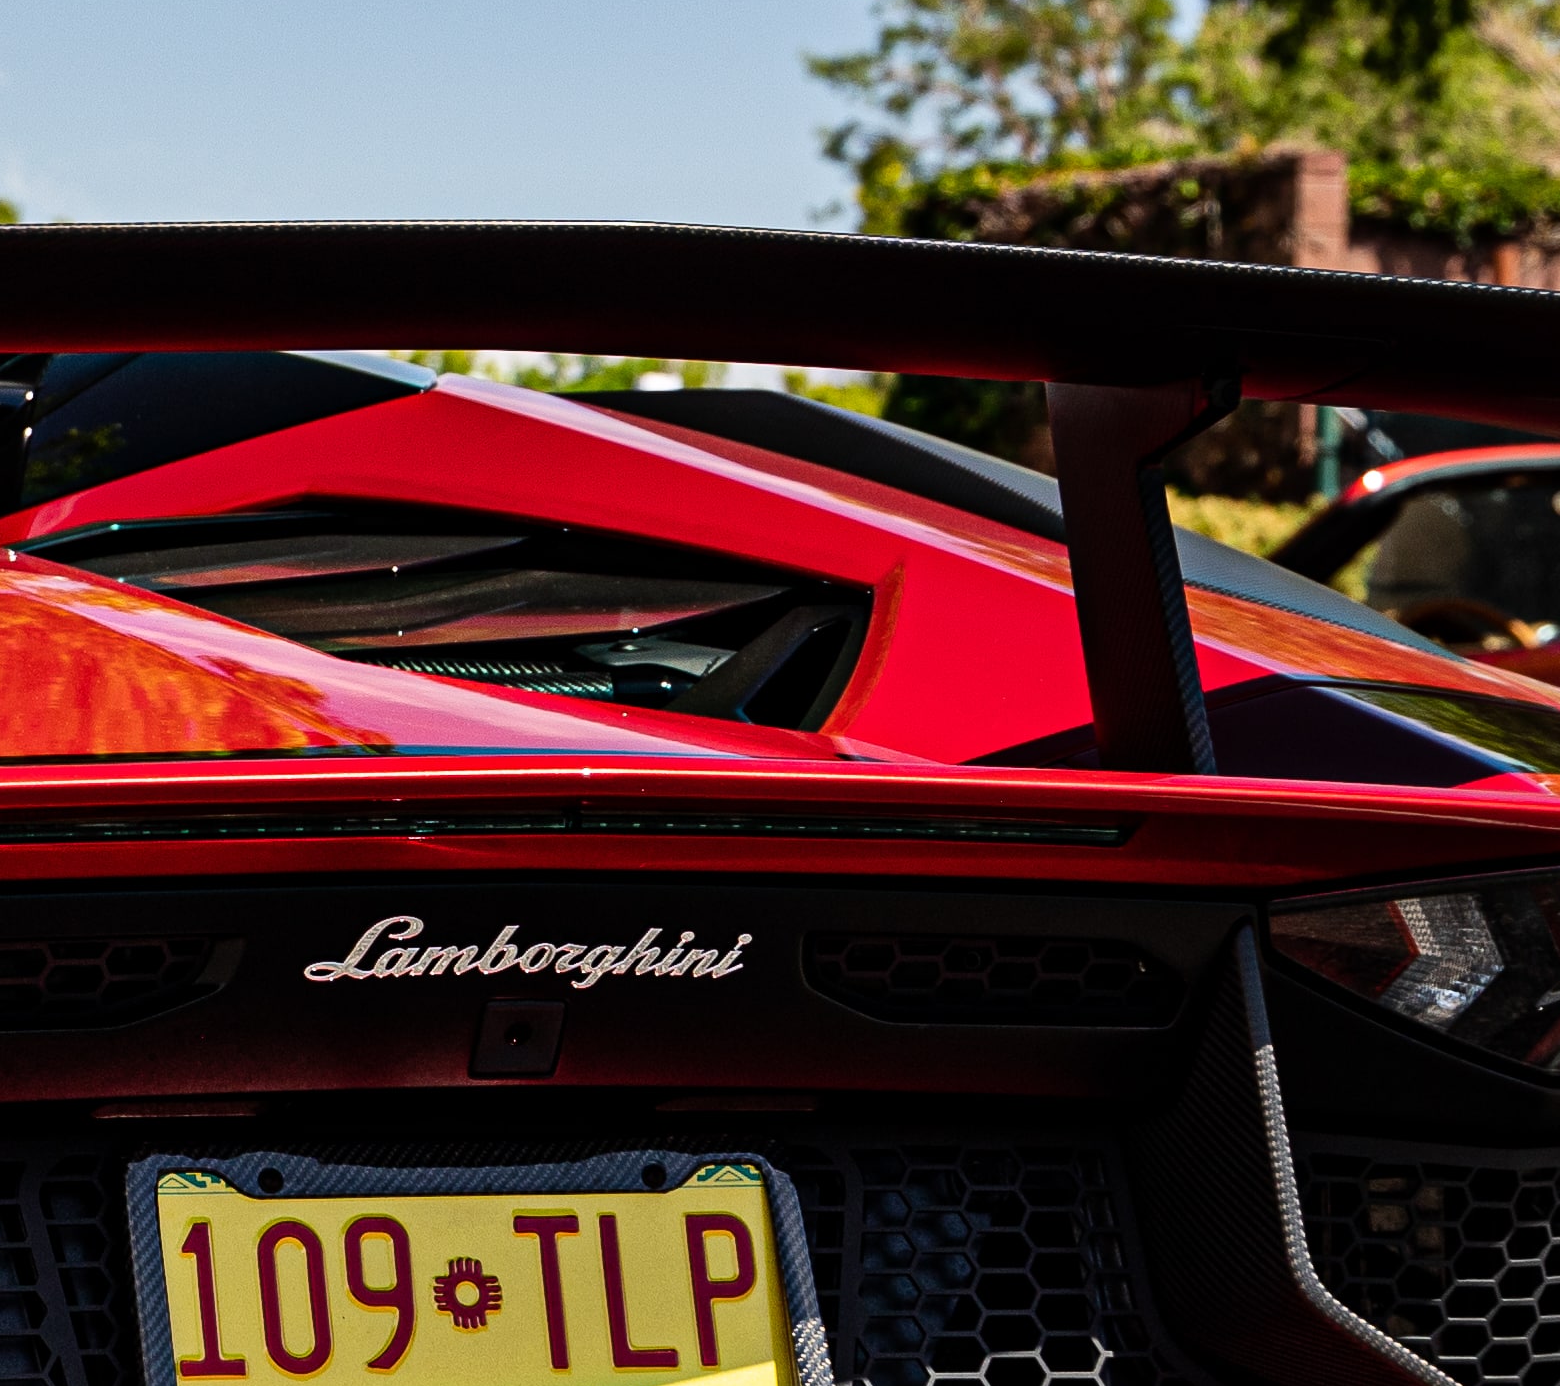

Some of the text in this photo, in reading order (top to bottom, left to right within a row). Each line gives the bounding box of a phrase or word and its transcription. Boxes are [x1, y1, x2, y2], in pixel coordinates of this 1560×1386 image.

[303, 915, 753, 989] Lamborghini
[179, 1209, 756, 1377] 109 TLP
